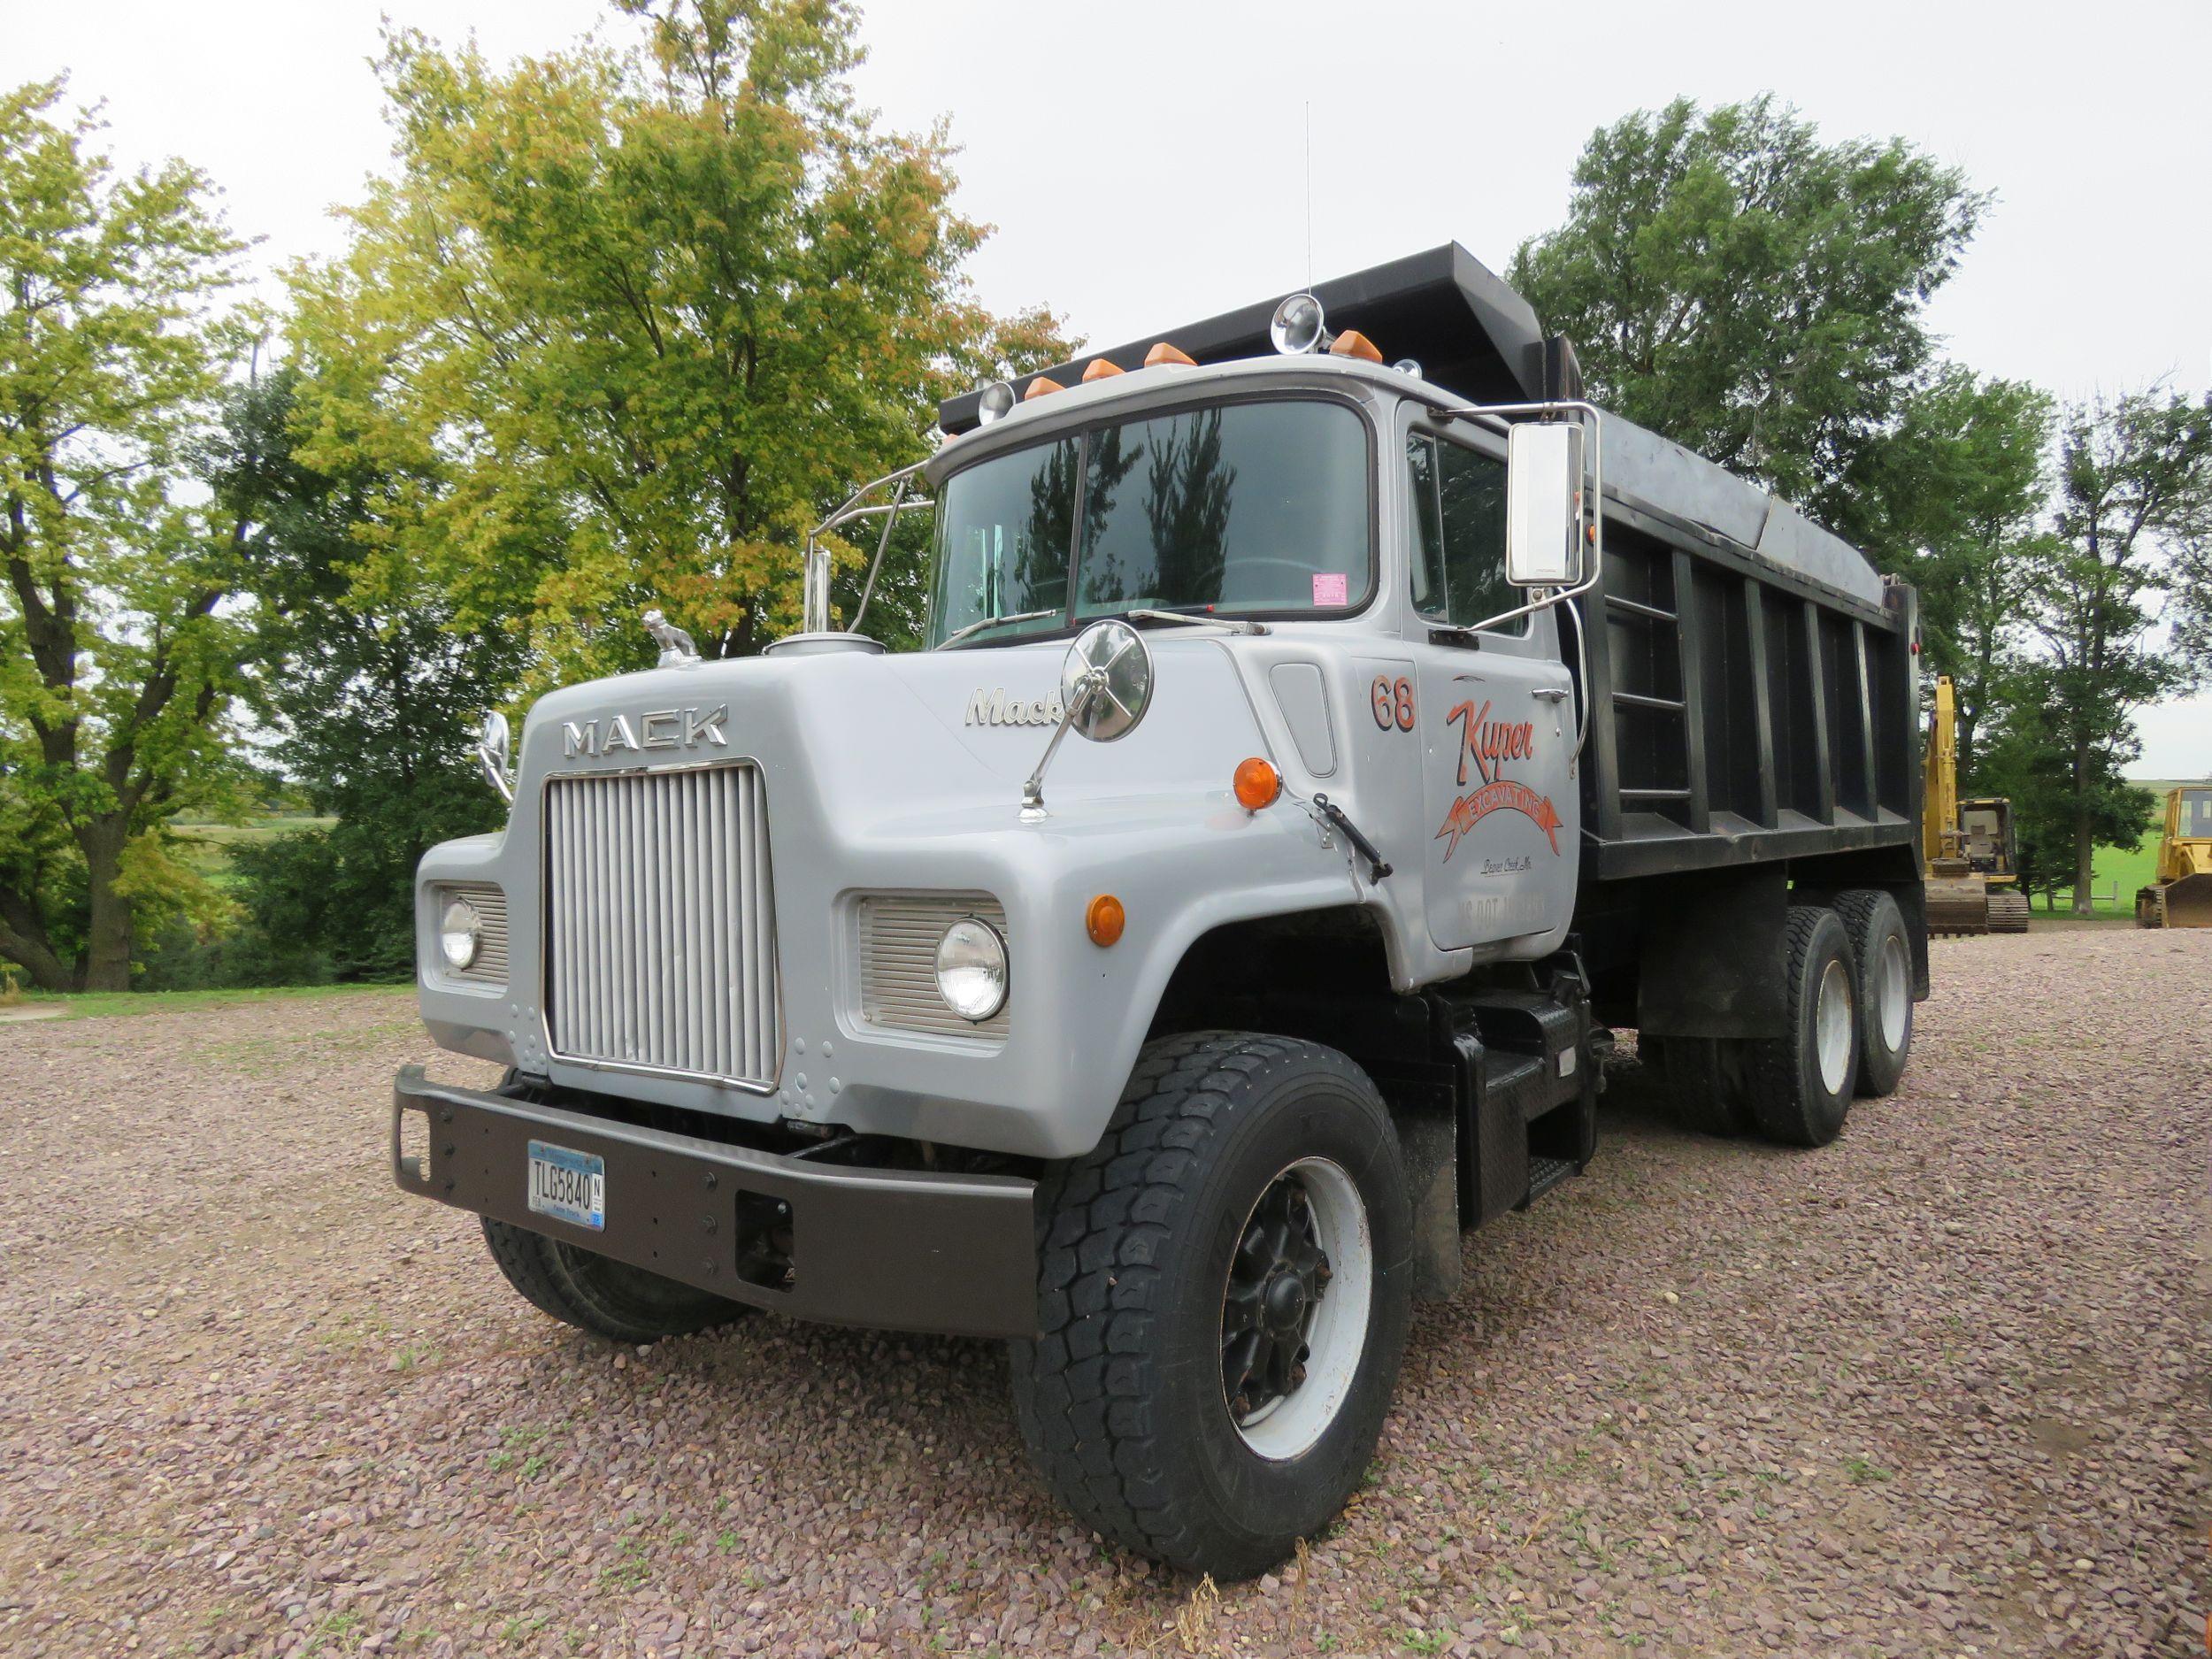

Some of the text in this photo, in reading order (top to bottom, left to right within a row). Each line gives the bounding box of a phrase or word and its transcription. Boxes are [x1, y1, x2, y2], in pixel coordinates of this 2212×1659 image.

[965, 687, 1065, 726] Mack
[1371, 674, 1415, 733] 68
[562, 703, 728, 758] MACK
[1446, 699, 1533, 787] Kuper
[1468, 784, 1540, 818] EXCAVATING
[534, 1160, 590, 1210] TLG5840
[594, 1177, 601, 1197] N
